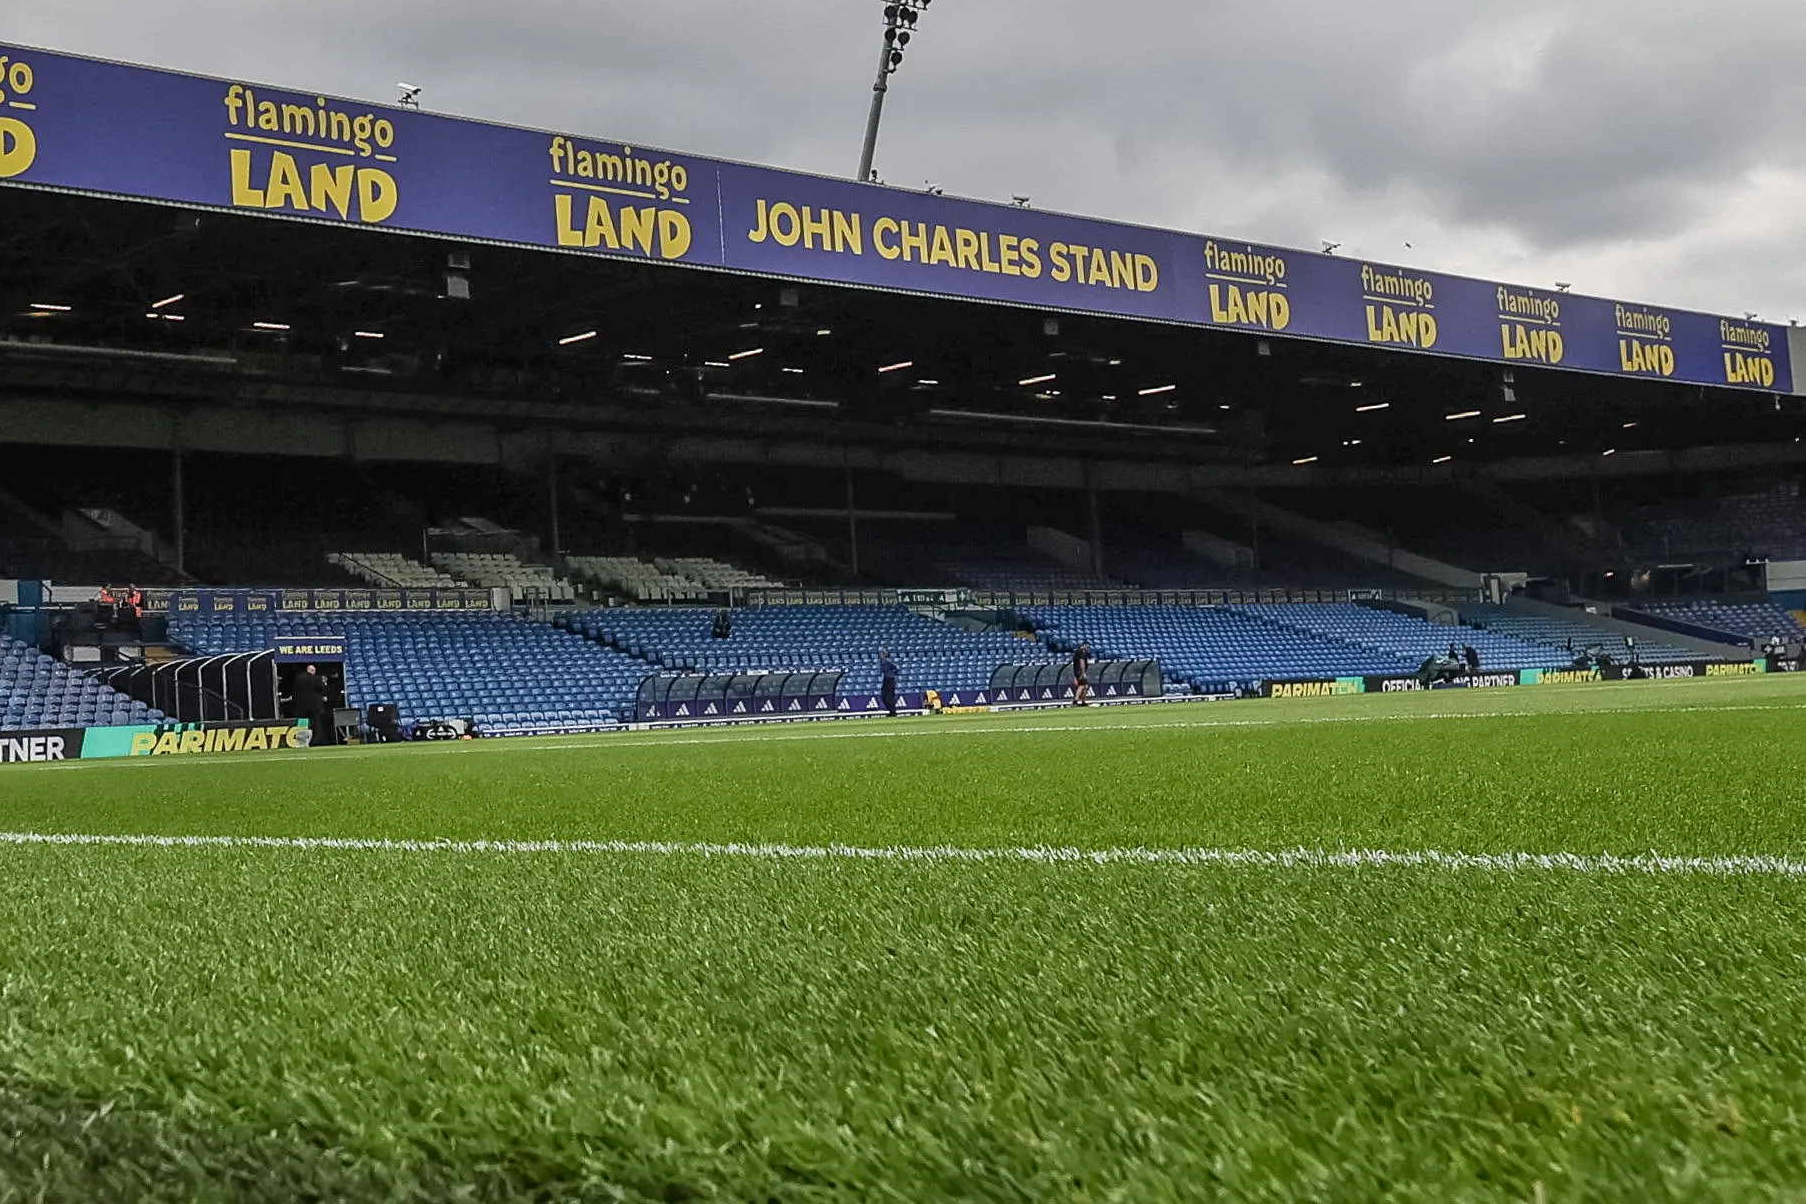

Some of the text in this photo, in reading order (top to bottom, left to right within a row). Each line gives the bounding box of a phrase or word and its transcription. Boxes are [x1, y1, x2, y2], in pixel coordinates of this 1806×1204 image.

[224, 85, 394, 157] flamingo
[230, 149, 398, 223] LAND
[549, 137, 687, 200] flamingo
[555, 195, 691, 260] LAND
[748, 198, 1159, 292] JOHN CHARLES STAND
[1204, 240, 1286, 285] flamingo
[1361, 264, 1433, 307] flamingo
[1496, 286, 1560, 324] flamingo
[1208, 283, 1291, 331] LAND
[1365, 305, 1438, 349] LAND
[1615, 303, 1670, 339] flamingo
[1500, 323, 1564, 365] LAND
[1720, 318, 1770, 352] flamingo
[1619, 339, 1675, 377] LAND
[1723, 352, 1775, 388] LAND
[279, 645, 343, 655] WE ARE LEEDS
[1271, 681, 1359, 698] PARIMATCH
[1382, 679, 1424, 693] OFFICIA
[1472, 674, 1515, 688] PARTNER
[1663, 665, 1694, 679] CASINO
